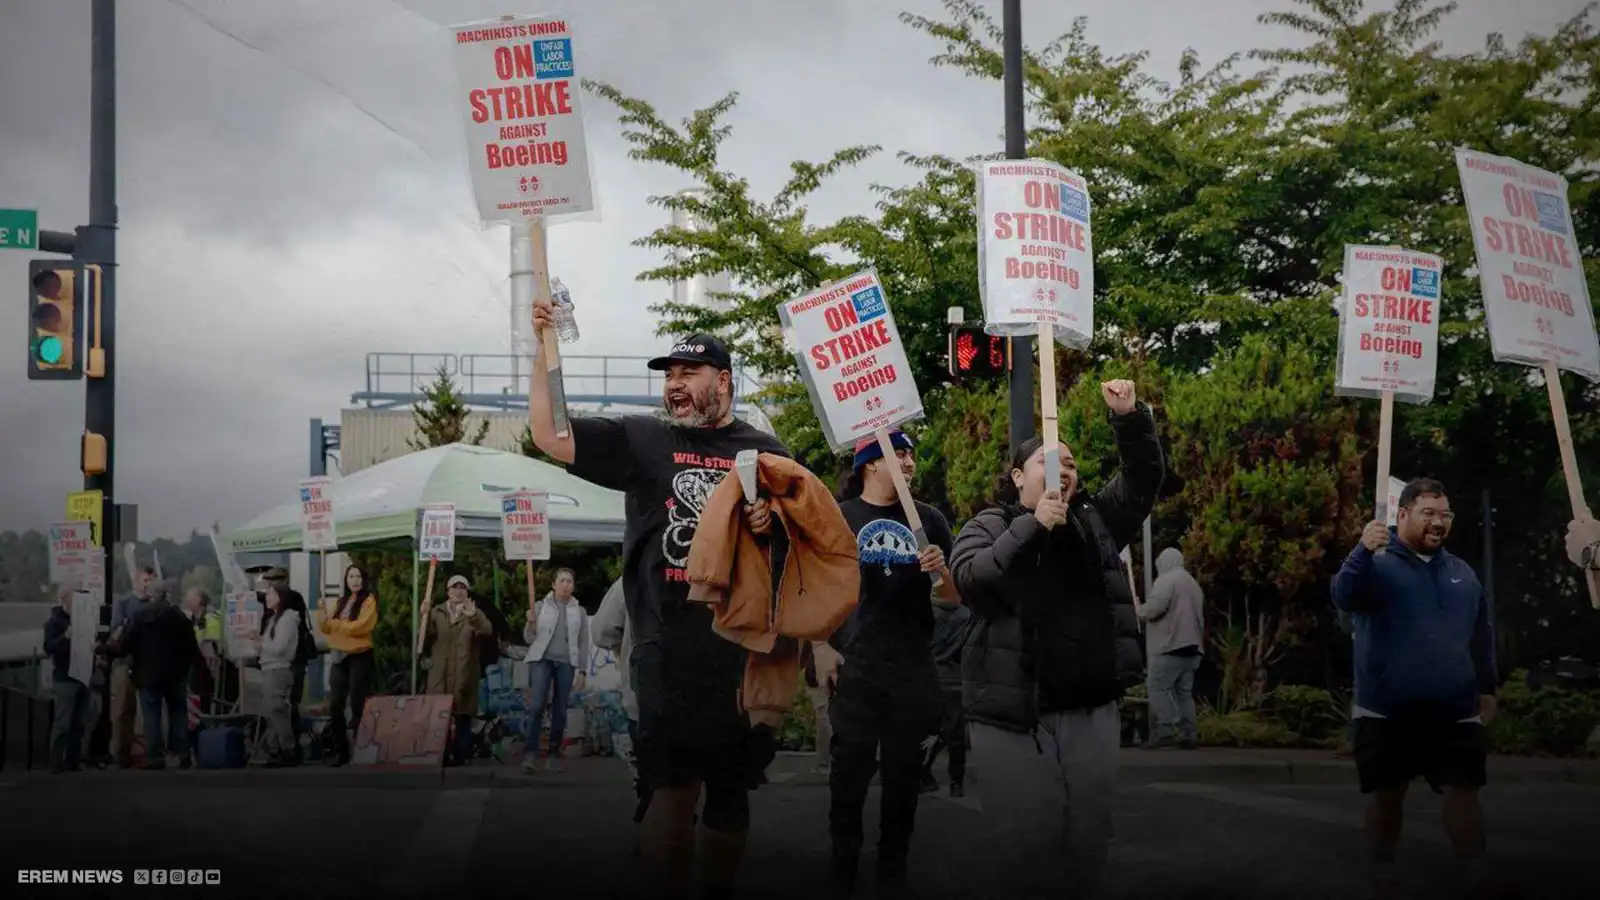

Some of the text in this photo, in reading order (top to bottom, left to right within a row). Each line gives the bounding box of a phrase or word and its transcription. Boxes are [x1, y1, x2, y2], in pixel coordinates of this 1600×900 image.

[456, 20, 566, 44] MACHINISTS UNION
[540, 40, 564, 51] UNFAIR
[542, 51, 564, 61] LABOR
[494, 43, 535, 81] ON
[469, 80, 572, 124] STRIKE
[499, 122, 547, 140] AGAINST
[485, 139, 568, 169] Boeing
[989, 164, 1057, 177] MACHINISTS
[1024, 180, 1060, 211] ON
[1502, 183, 1540, 223] ON
[17, 227, 30, 245] N
[994, 211, 1086, 252] STRIKE
[1482, 216, 1573, 269] STRIKE
[1021, 244, 1067, 260] AGAINST
[1355, 251, 1411, 265] MACHINISTS
[1005, 257, 1079, 290] Boeing
[1381, 267, 1412, 292] ON
[791, 276, 873, 314] MACHINISTS UNION
[1502, 274, 1575, 317] Boeing
[824, 299, 859, 333] ON
[1355, 293, 1432, 325] STRIKE
[1374, 322, 1412, 336] AGAINST
[810, 319, 892, 371] STRIKE
[1360, 332, 1423, 358] Boeing
[841, 354, 878, 377] AGAINST
[832, 363, 897, 402] Boeing
[673, 452, 702, 465] WILL
[74, 498, 94, 509] STOP
[304, 500, 332, 514] STRIKE
[517, 499, 532, 511] ON
[507, 512, 545, 525] STRIKE
[53, 540, 86, 551] STRIKE
